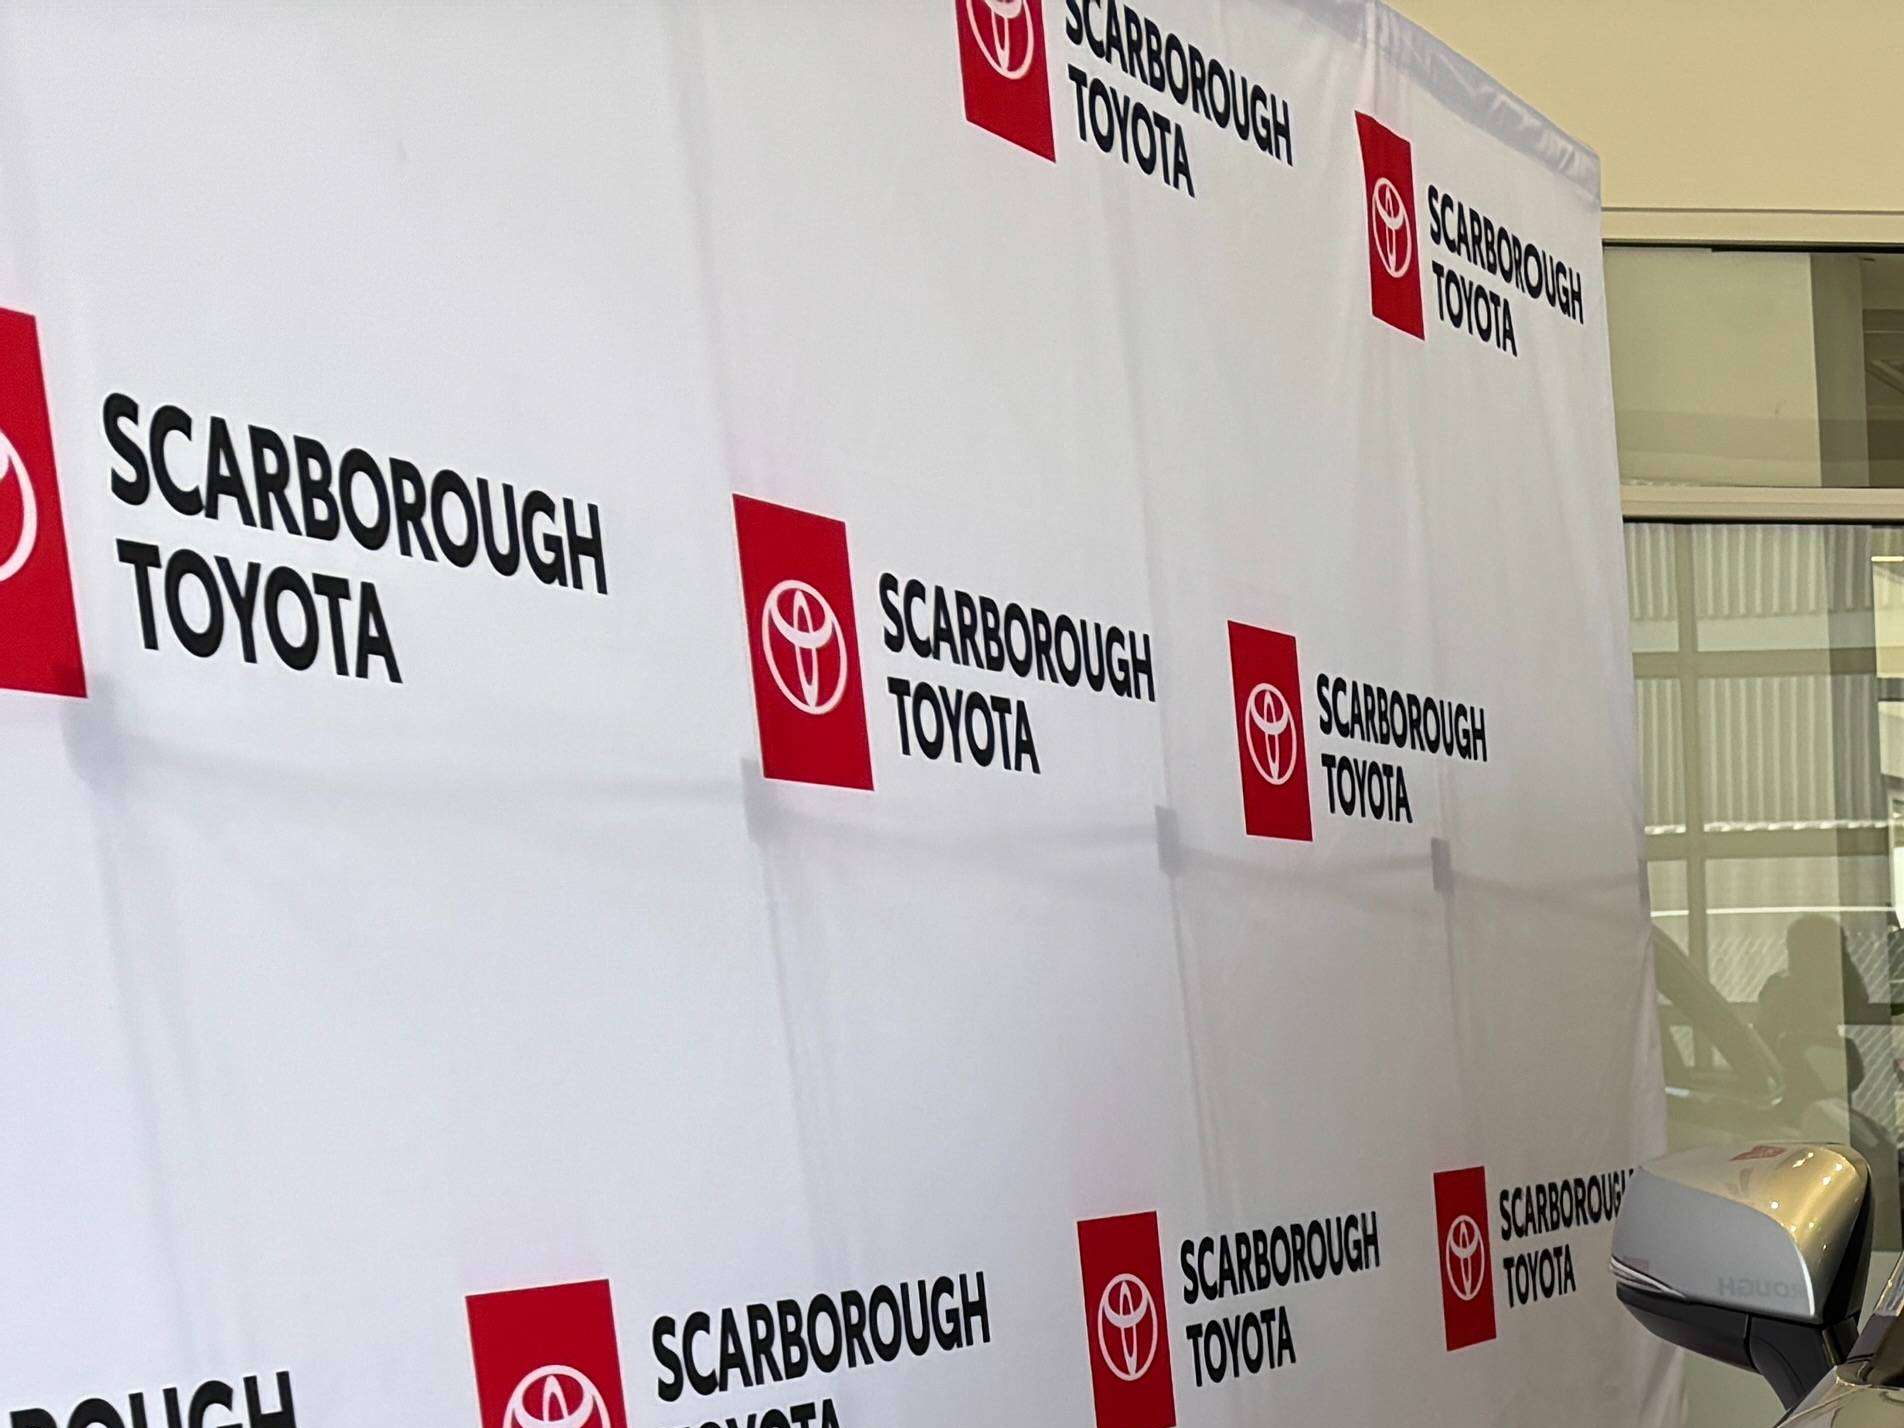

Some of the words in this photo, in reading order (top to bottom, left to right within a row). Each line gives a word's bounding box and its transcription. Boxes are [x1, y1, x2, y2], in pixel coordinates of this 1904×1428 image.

[1065, 0, 1293, 166] SCARBOROUGH
[1068, 64, 1195, 198] TOYOTA
[1427, 184, 1583, 324] SCARBOROUGH
[1431, 260, 1517, 357] TOYOTA
[103, 392, 607, 594] SCARBOROUGH
[116, 539, 403, 684] TOYOTA
[879, 571, 1156, 702] SCARBOROUGH
[887, 677, 1041, 775] TOYOTA
[1317, 672, 1488, 763] SCARBOROUGH
[1321, 752, 1413, 824] TOYOTA
[1500, 1168, 1634, 1241] SCARBOROUG
[1180, 1211, 1381, 1304] SCARBOROUGH
[1503, 1243, 1576, 1308] TOYOTA
[652, 1272, 991, 1402] SCARBOROUGH
[1185, 1305, 1297, 1387] TOYOTA
